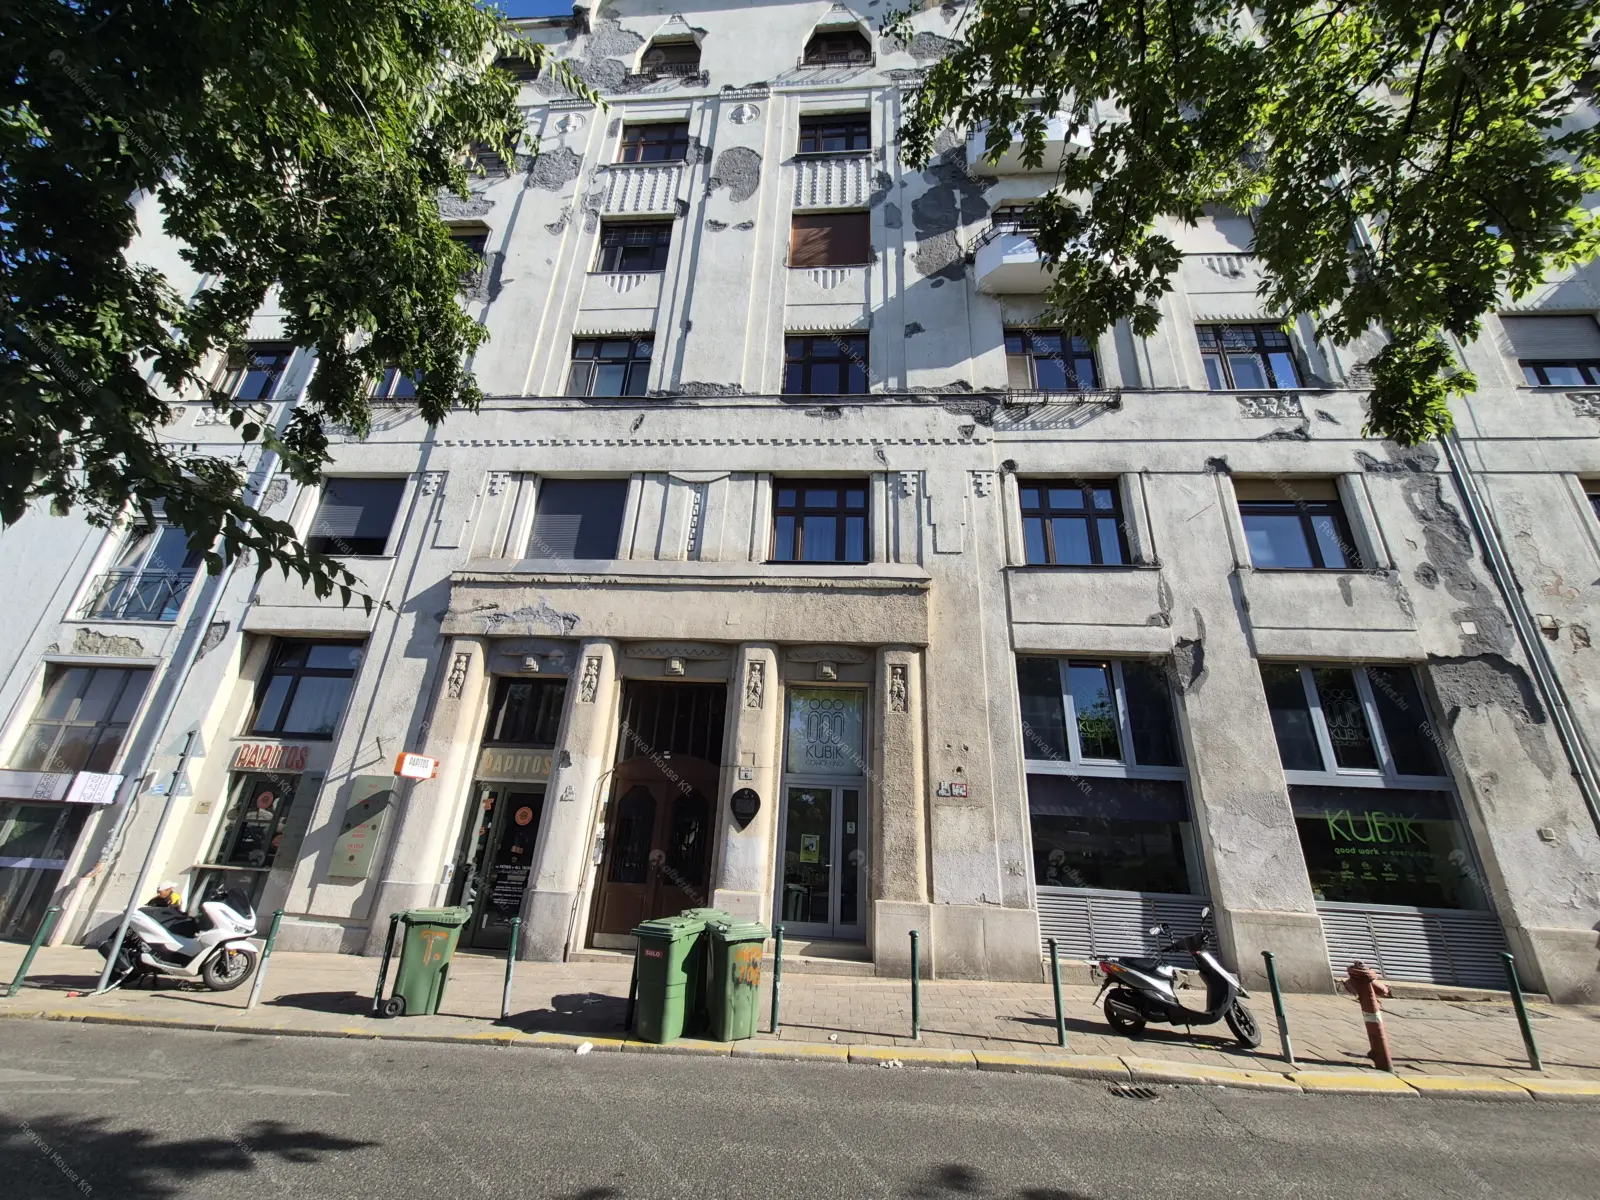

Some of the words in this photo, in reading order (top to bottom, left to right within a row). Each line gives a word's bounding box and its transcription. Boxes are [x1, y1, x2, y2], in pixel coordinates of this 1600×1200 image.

[234, 744, 310, 771] PAPITOS
[806, 745, 844, 759] KUBIK
[408, 756, 429, 768] PAPITOS
[484, 753, 552, 774] PAPITOS
[1325, 810, 1427, 844] KUBIK
[1334, 846, 1356, 855] good
[1358, 848, 1380, 856] work
[645, 950, 660, 958] SULO
